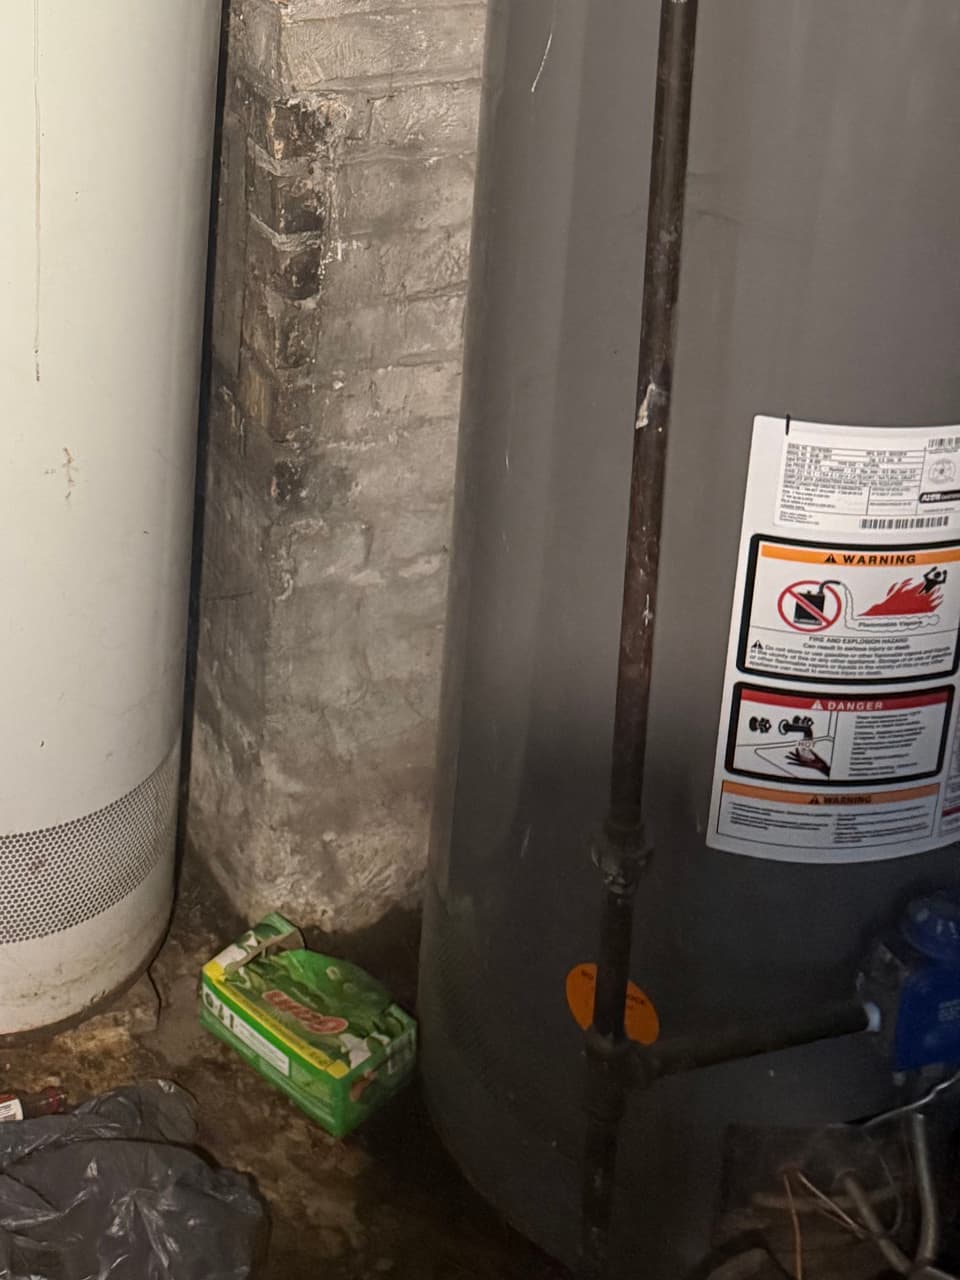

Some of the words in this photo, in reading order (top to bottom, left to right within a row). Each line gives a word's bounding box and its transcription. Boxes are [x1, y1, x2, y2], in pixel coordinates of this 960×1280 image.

[843, 553, 916, 565] WARNING
[827, 701, 884, 711] DANGER
[797, 740, 817, 749] HOT
[823, 794, 873, 805] WARNING
